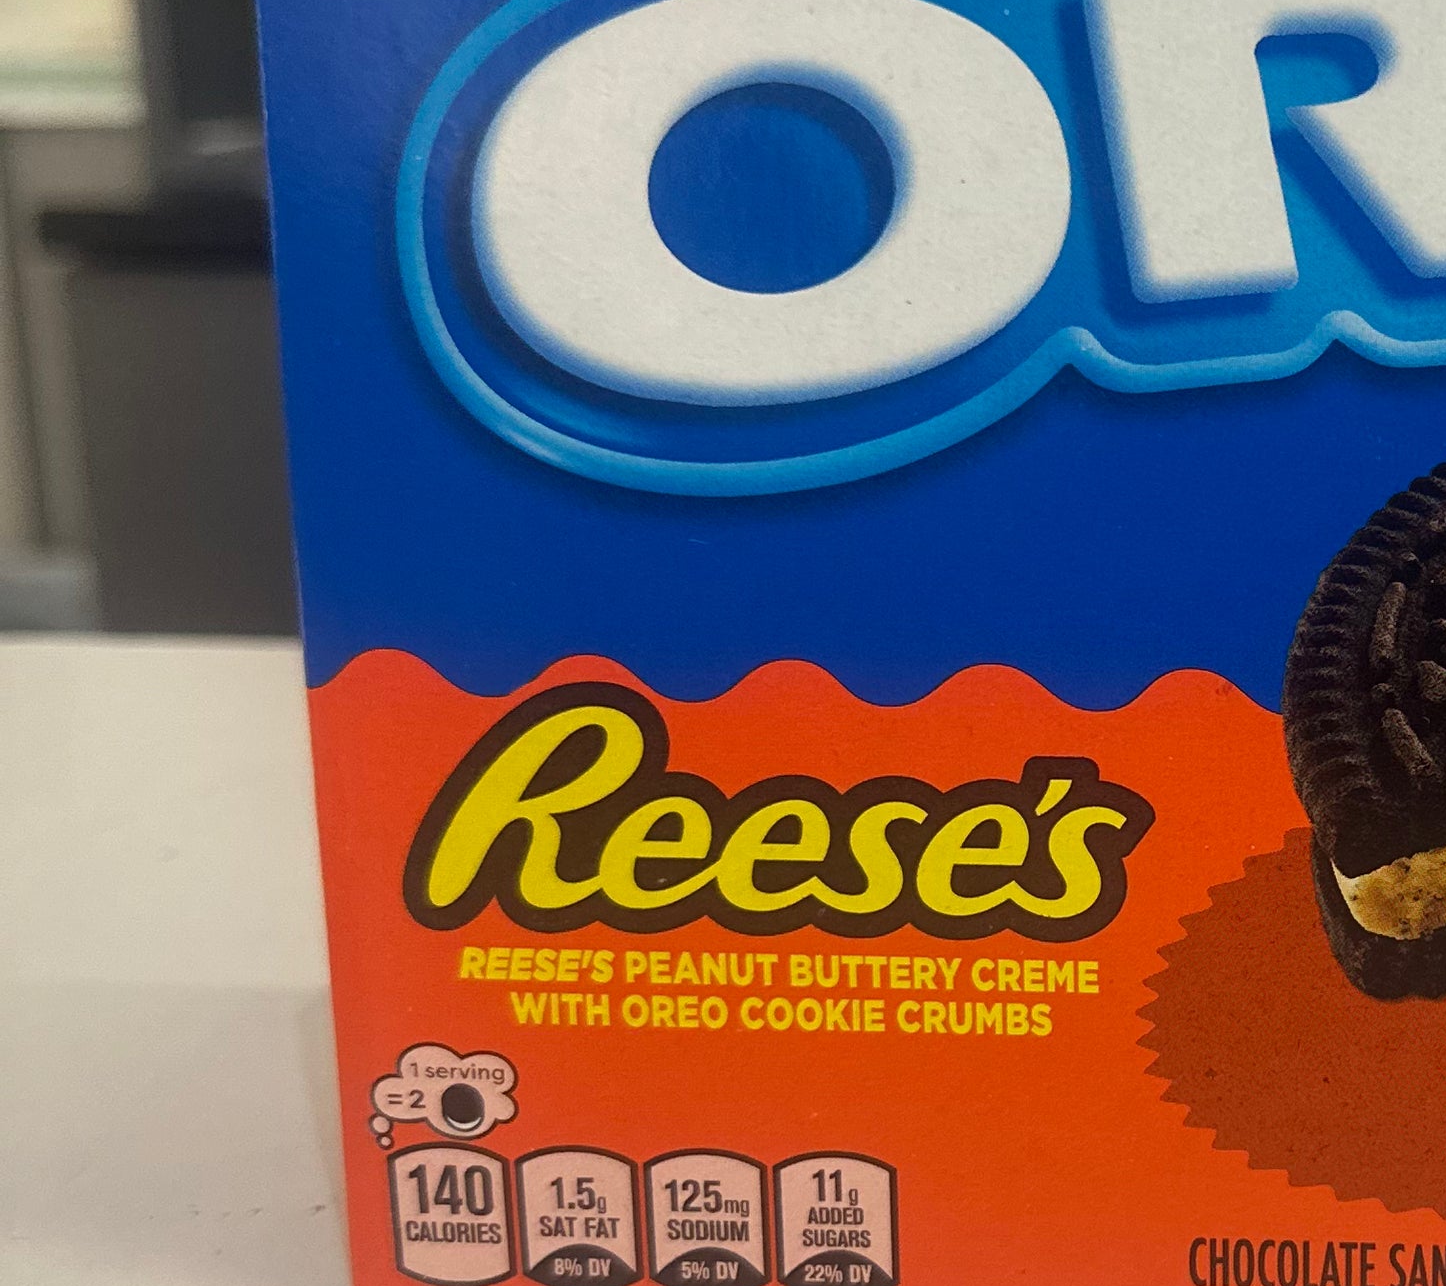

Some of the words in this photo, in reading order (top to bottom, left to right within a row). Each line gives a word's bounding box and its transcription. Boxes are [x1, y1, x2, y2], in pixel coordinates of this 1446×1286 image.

[428, 705, 1127, 918] Reese's
[460, 946, 615, 983] REESE'S
[625, 950, 780, 986] PEANUT
[790, 954, 962, 991] BUTTERY
[970, 958, 1100, 994] CREME
[510, 991, 612, 1027] WITH
[621, 994, 729, 1030] OREO
[739, 997, 886, 1033] COOKIE
[896, 1001, 1053, 1037] CRUMBS
[409, 1062, 419, 1078] 1
[425, 1063, 505, 1084] serving
[408, 1164, 495, 1216] 140
[550, 1176, 608, 1214] 1.5g
[664, 1178, 751, 1217] 125mg
[539, 1215, 577, 1238] SAT
[584, 1217, 621, 1239] FAT
[807, 1206, 865, 1226] ADDED
[405, 1220, 502, 1245] CALORIES
[667, 1218, 751, 1242] SODIUM
[802, 1228, 872, 1248] SUGARS
[554, 1258, 583, 1277] 8%
[588, 1259, 612, 1277] DV
[681, 1261, 711, 1280] 5%
[716, 1261, 739, 1280] DV
[804, 1264, 844, 1283] 22%
[849, 1264, 873, 1283] DV
